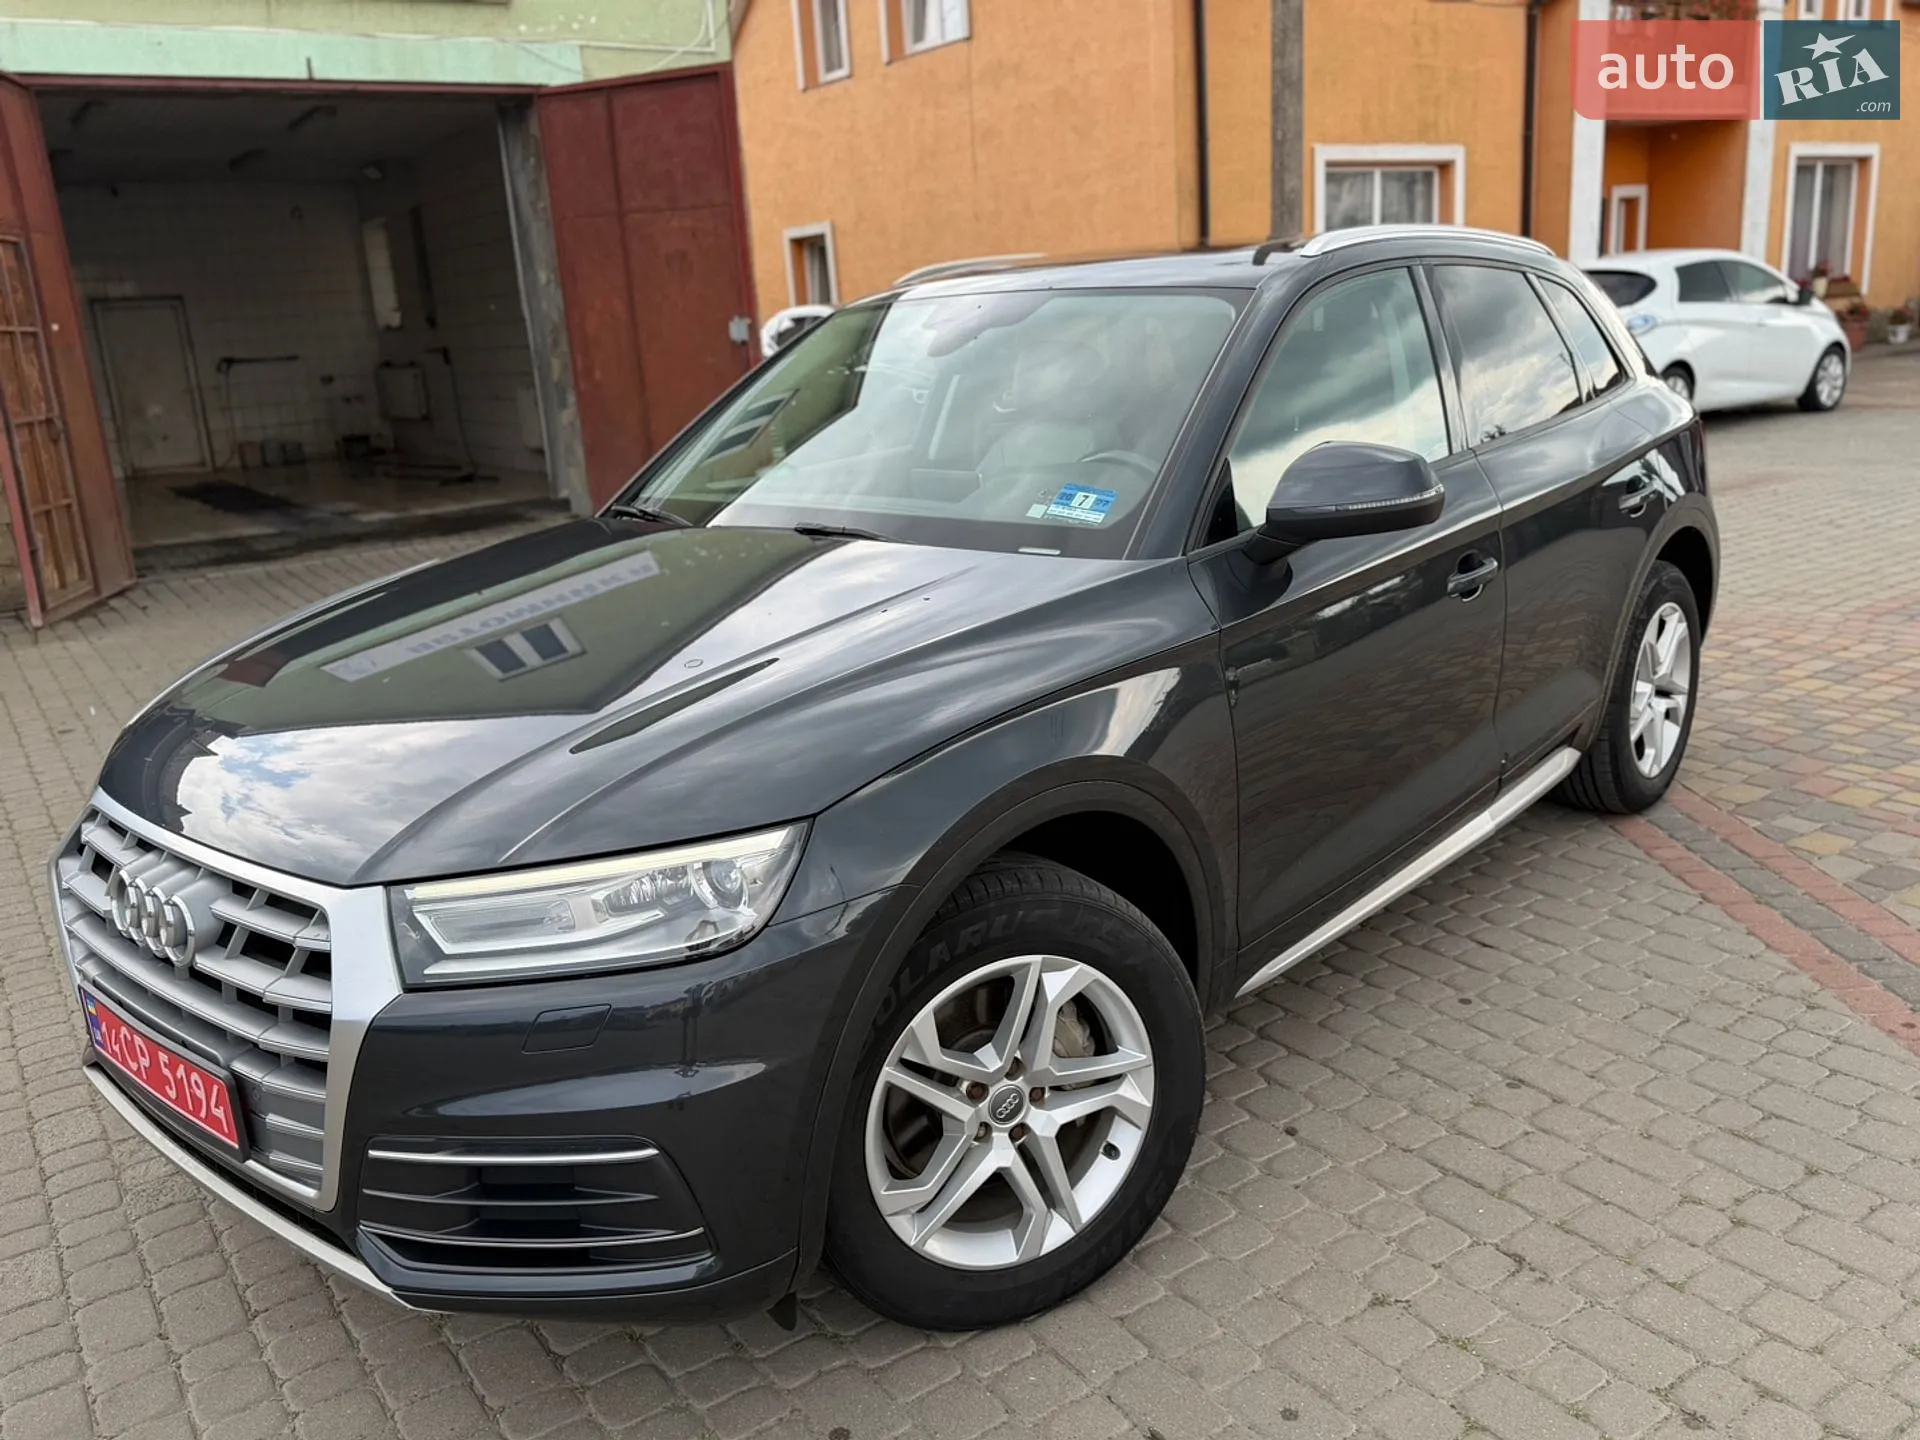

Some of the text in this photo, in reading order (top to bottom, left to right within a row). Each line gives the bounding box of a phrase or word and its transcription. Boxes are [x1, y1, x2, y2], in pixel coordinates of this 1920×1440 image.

[1079, 494, 1089, 506] 7
[101, 1021, 229, 1134] 14CP 5194
